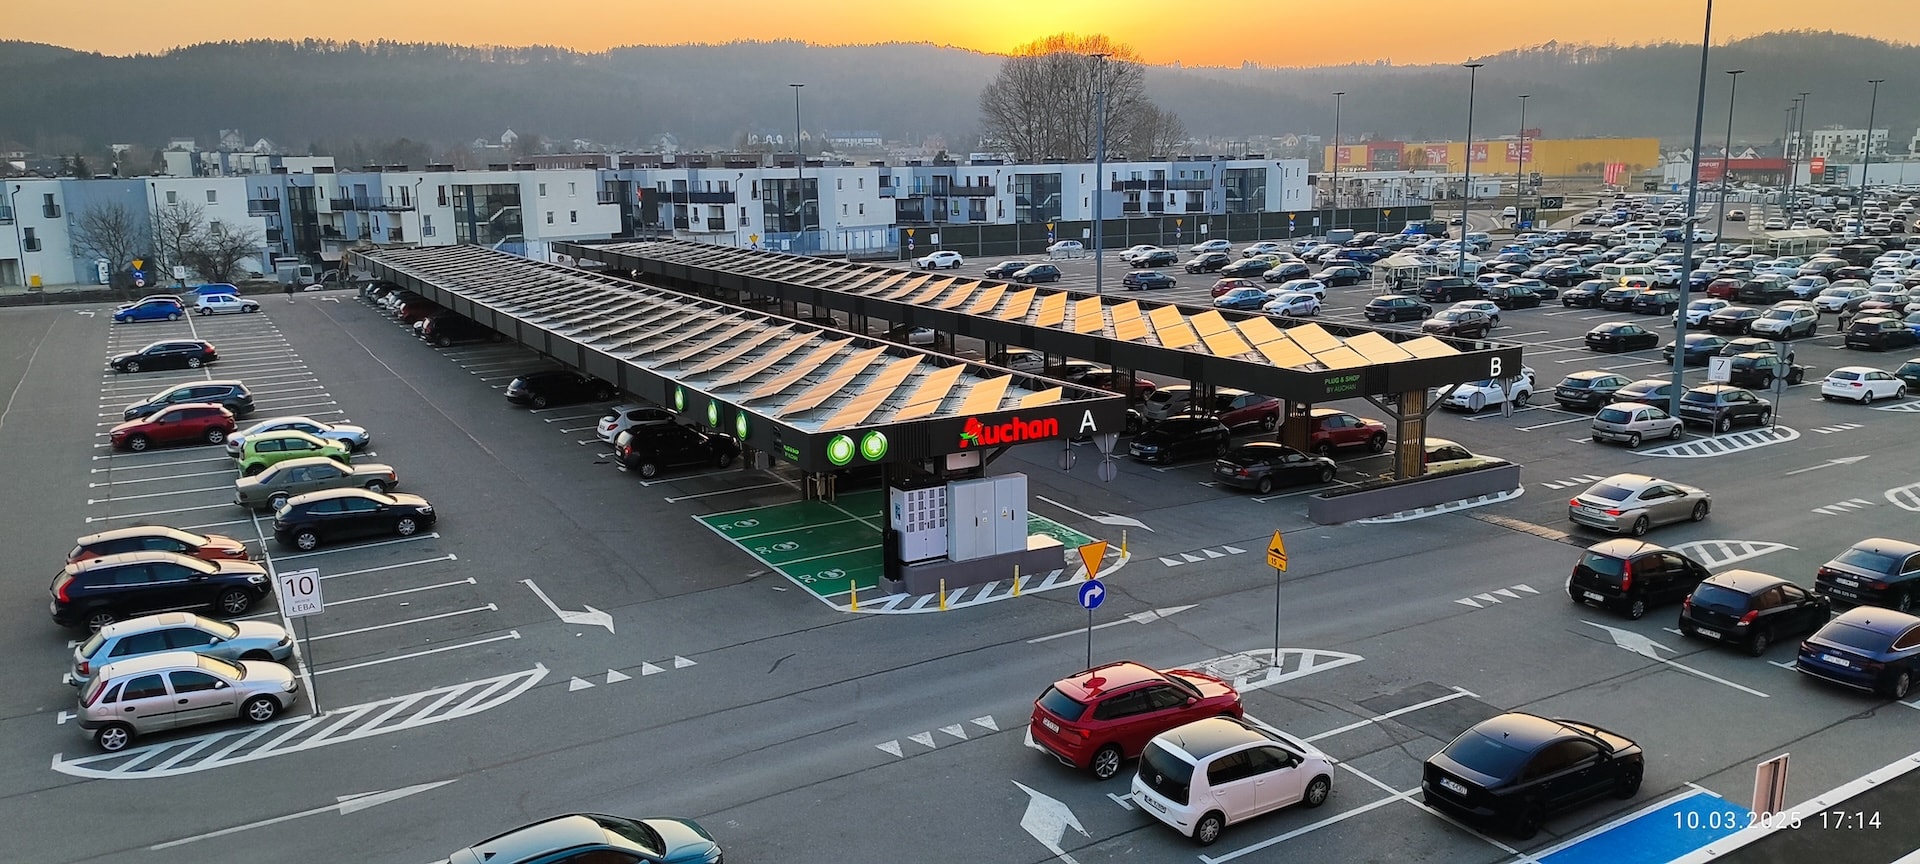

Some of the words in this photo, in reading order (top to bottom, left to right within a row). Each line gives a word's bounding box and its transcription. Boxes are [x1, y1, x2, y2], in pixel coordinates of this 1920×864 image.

[1490, 357, 1502, 377] B
[1717, 360, 1725, 371] 7
[1324, 376, 1340, 385] PLUG
[1345, 374, 1361, 383] SHOP
[1079, 409, 1098, 433] A
[959, 417, 1058, 448] Auchan
[754, 545, 772, 555] DC
[798, 574, 817, 584] DC
[285, 576, 314, 597] 10
[291, 602, 316, 613] ŁEBA
